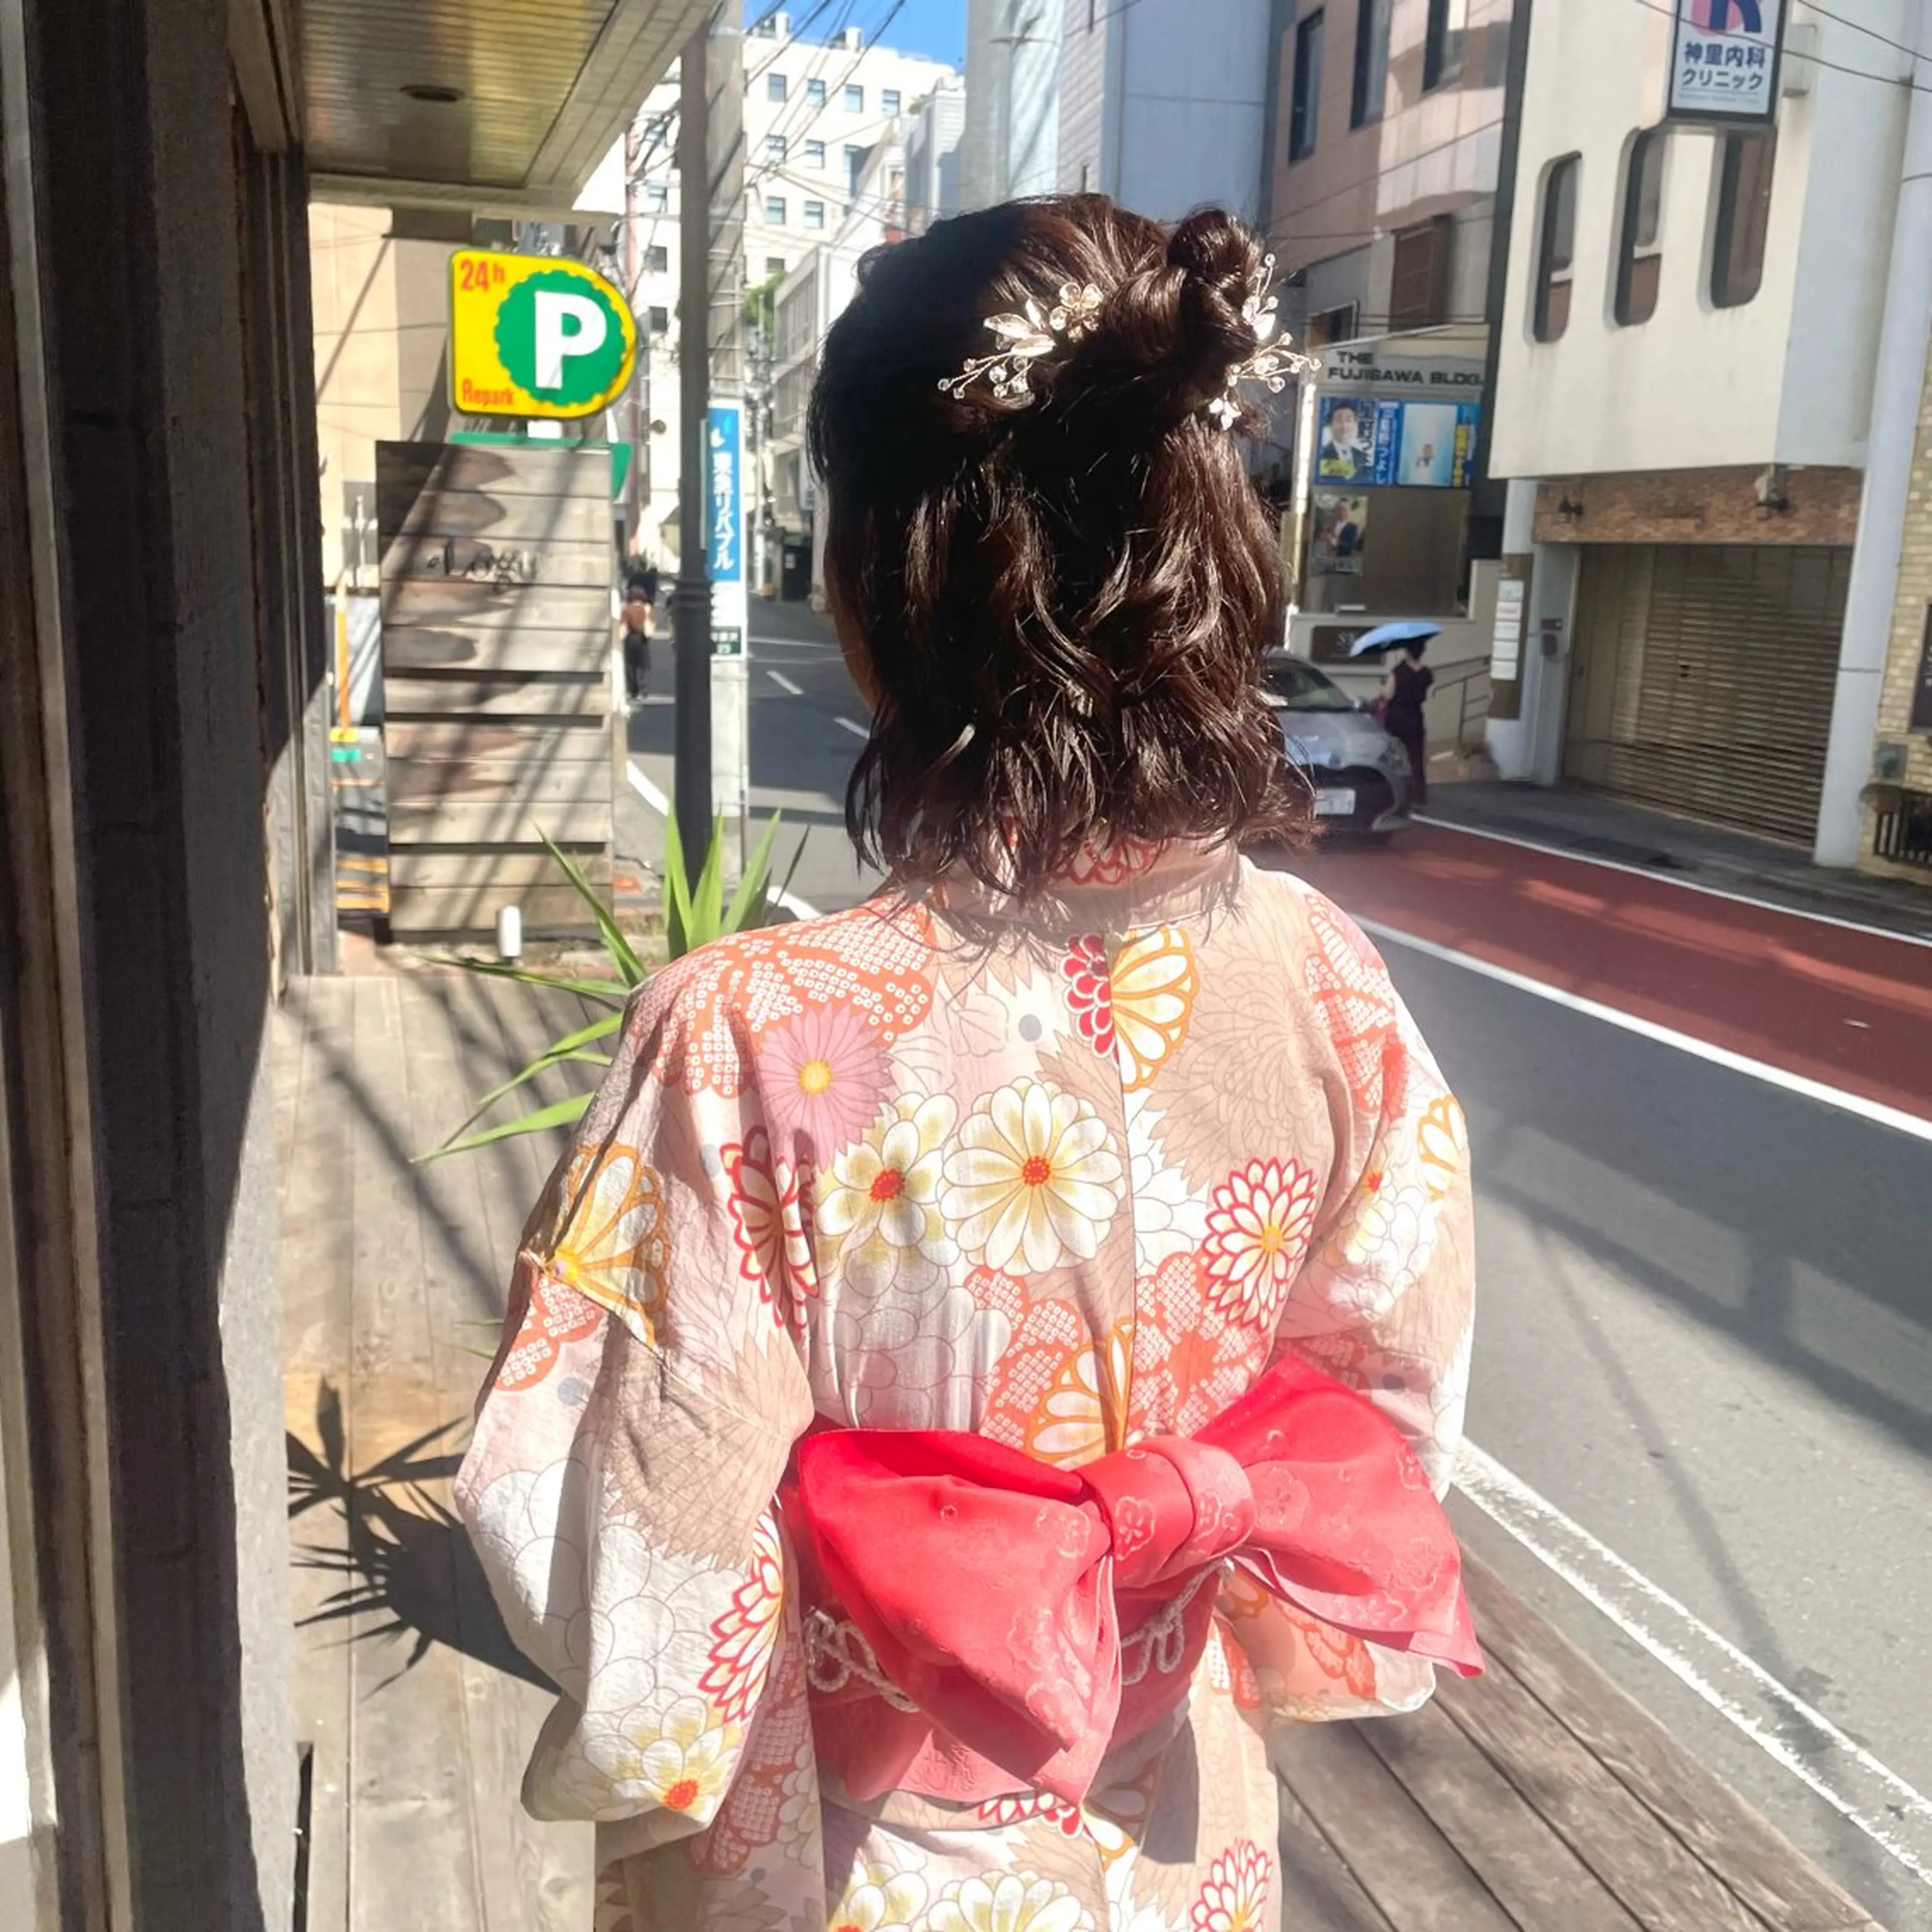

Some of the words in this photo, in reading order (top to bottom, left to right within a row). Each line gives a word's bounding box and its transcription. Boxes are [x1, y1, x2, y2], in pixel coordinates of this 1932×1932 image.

[1684, 41, 1765, 68] 神里内科
[1682, 69, 1763, 90] クリニック
[534, 290, 607, 390] P
[1336, 351, 1374, 365] THE
[1328, 367, 1423, 383] FUJISAWA
[461, 378, 514, 406] Repark
